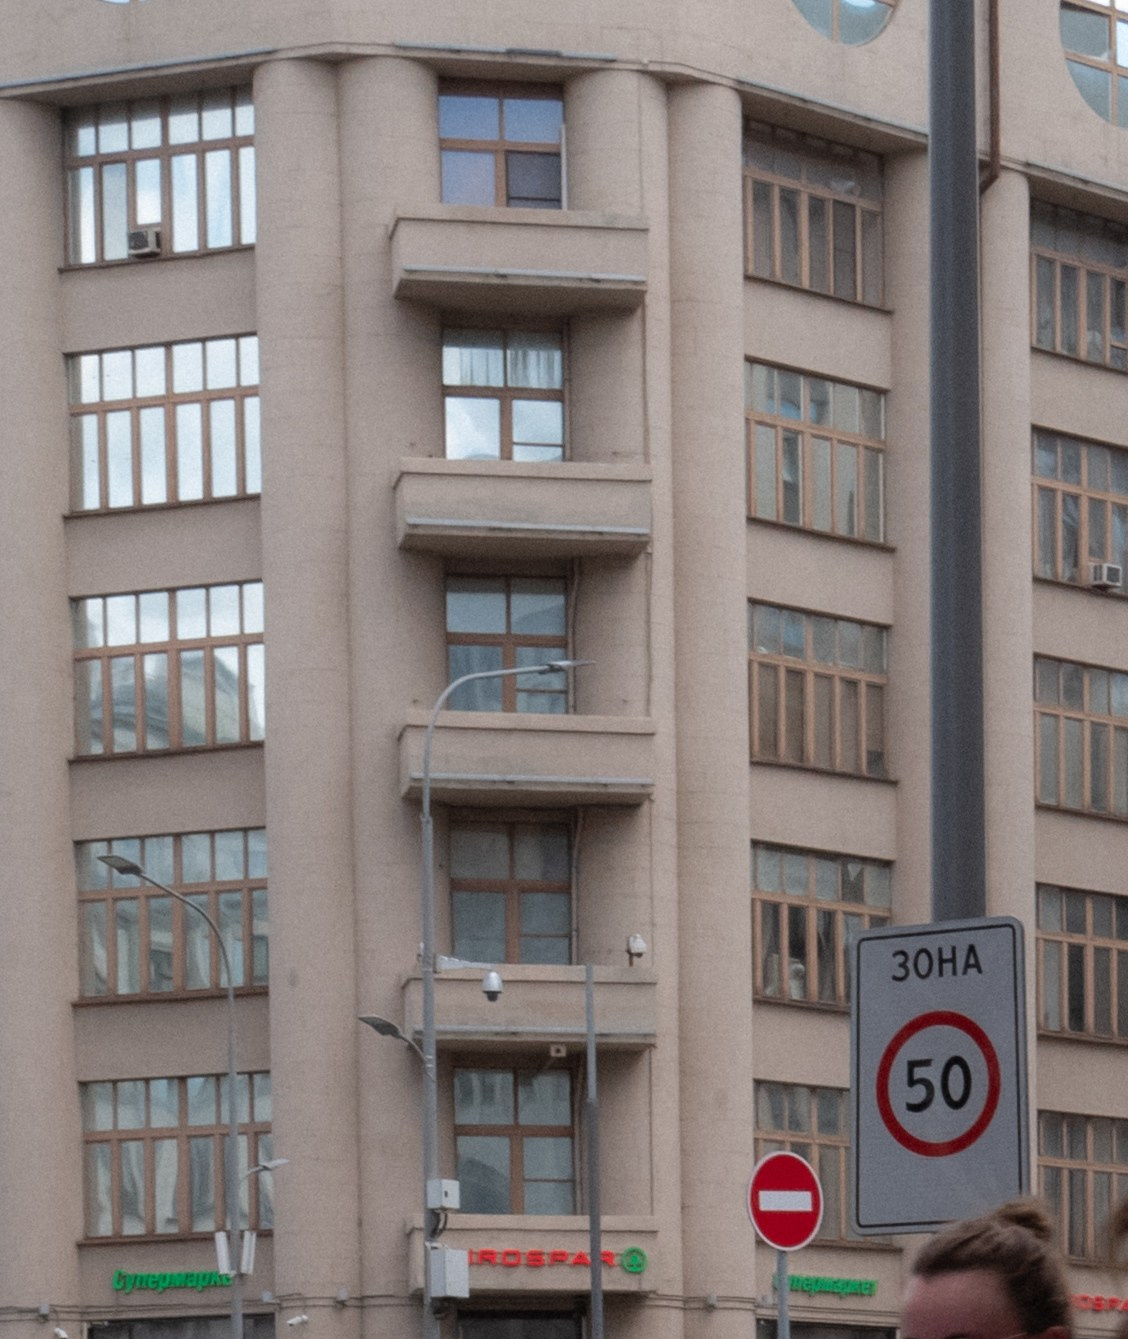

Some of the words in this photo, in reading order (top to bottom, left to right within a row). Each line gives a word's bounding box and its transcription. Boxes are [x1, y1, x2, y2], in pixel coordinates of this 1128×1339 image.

[891, 943, 983, 982] ЗОНА
[905, 1055, 972, 1113] 50
[468, 1249, 616, 1267] ROSPAR
[112, 1269, 232, 1294] Супермарке
